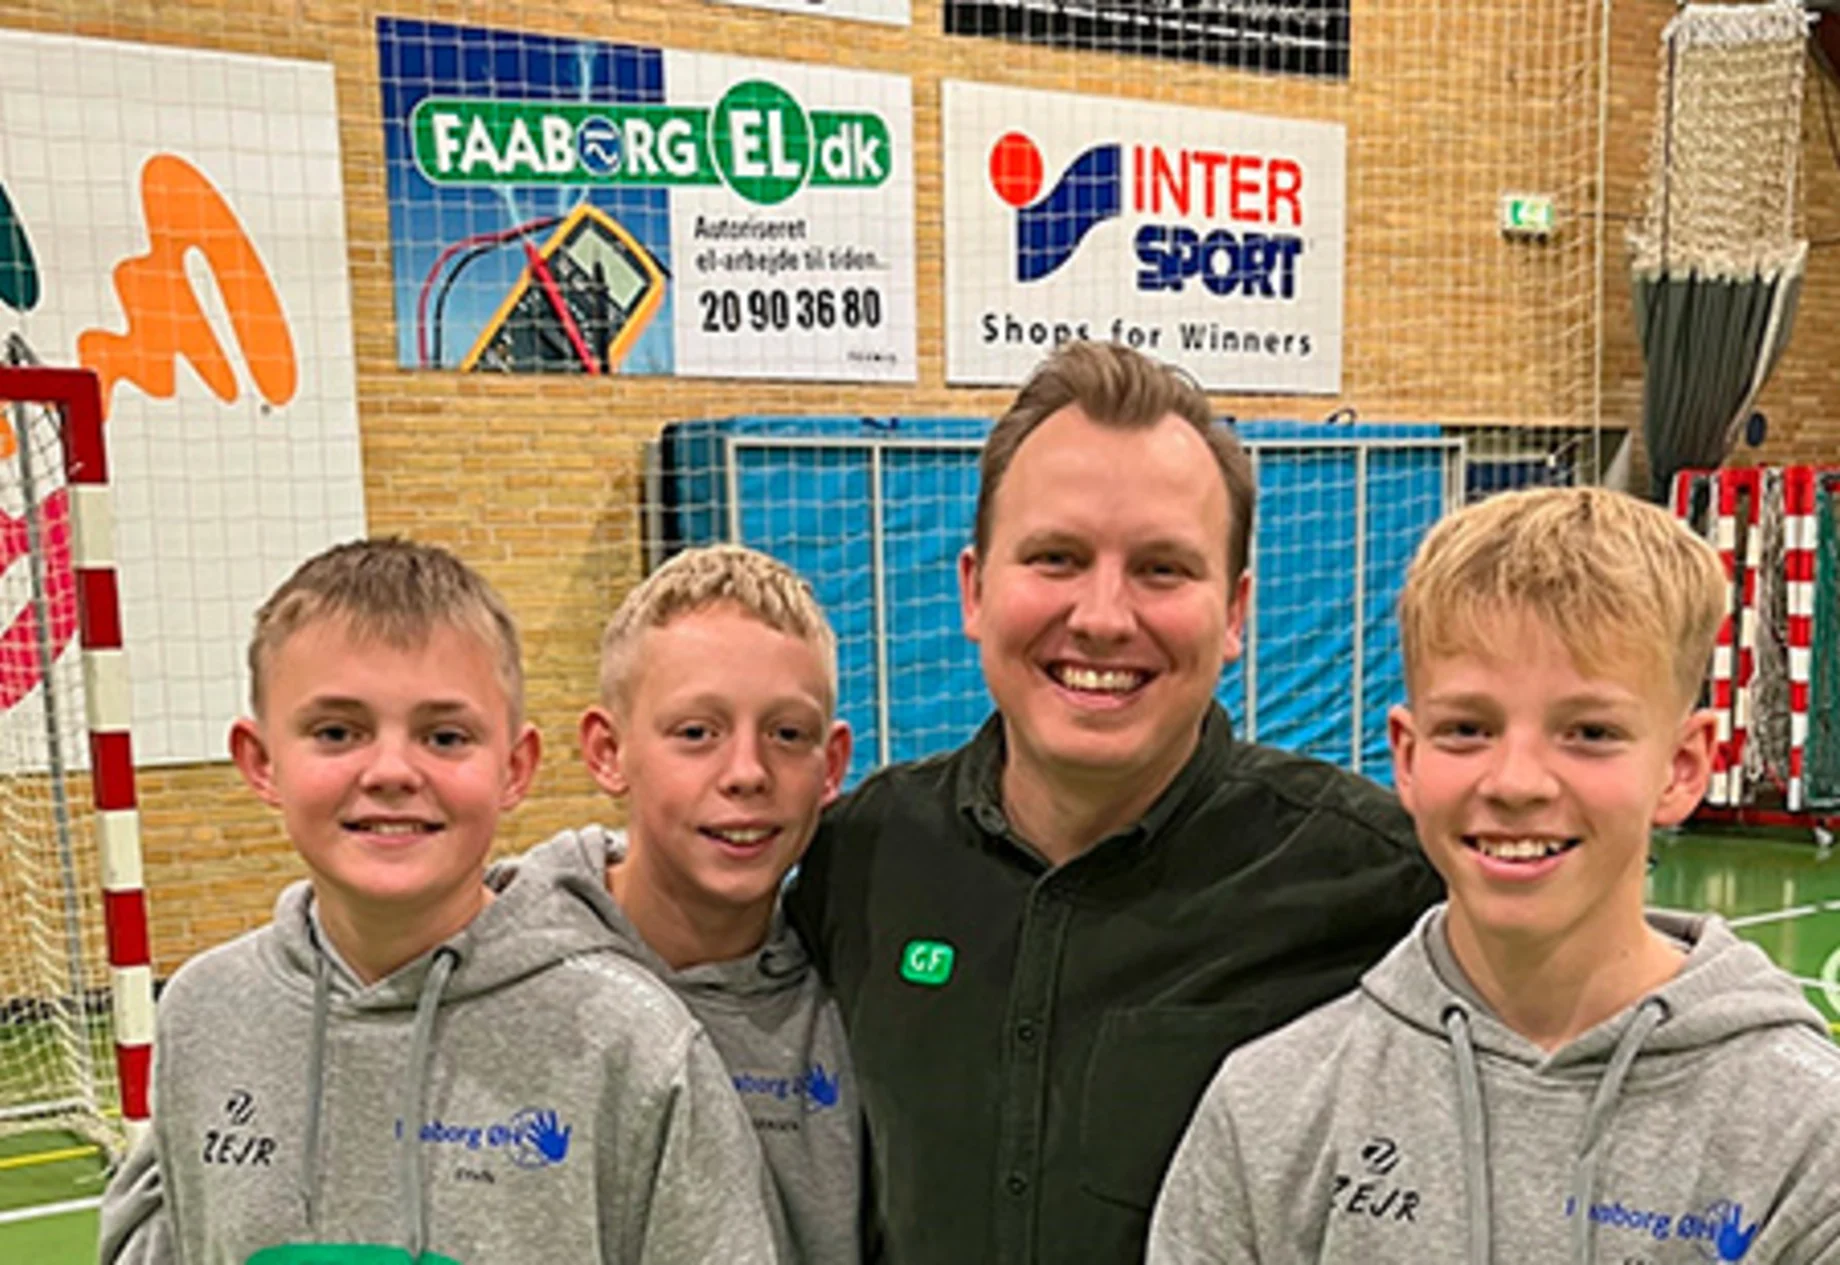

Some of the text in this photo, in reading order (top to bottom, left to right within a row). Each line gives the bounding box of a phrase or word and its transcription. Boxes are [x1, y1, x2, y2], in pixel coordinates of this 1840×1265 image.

[728, 109, 801, 178] EL
[820, 122, 884, 179] dk
[1133, 144, 1303, 227] INTER
[694, 215, 806, 240] Autoriseret
[695, 247, 799, 277] el-arbejde
[803, 247, 827, 271] til
[1135, 224, 1304, 299] SPORT
[700, 286, 881, 332] 20 90 36 80
[981, 312, 1312, 357] Shops for Winners
[909, 944, 949, 972] GF
[203, 1130, 278, 1167] ZEJR
